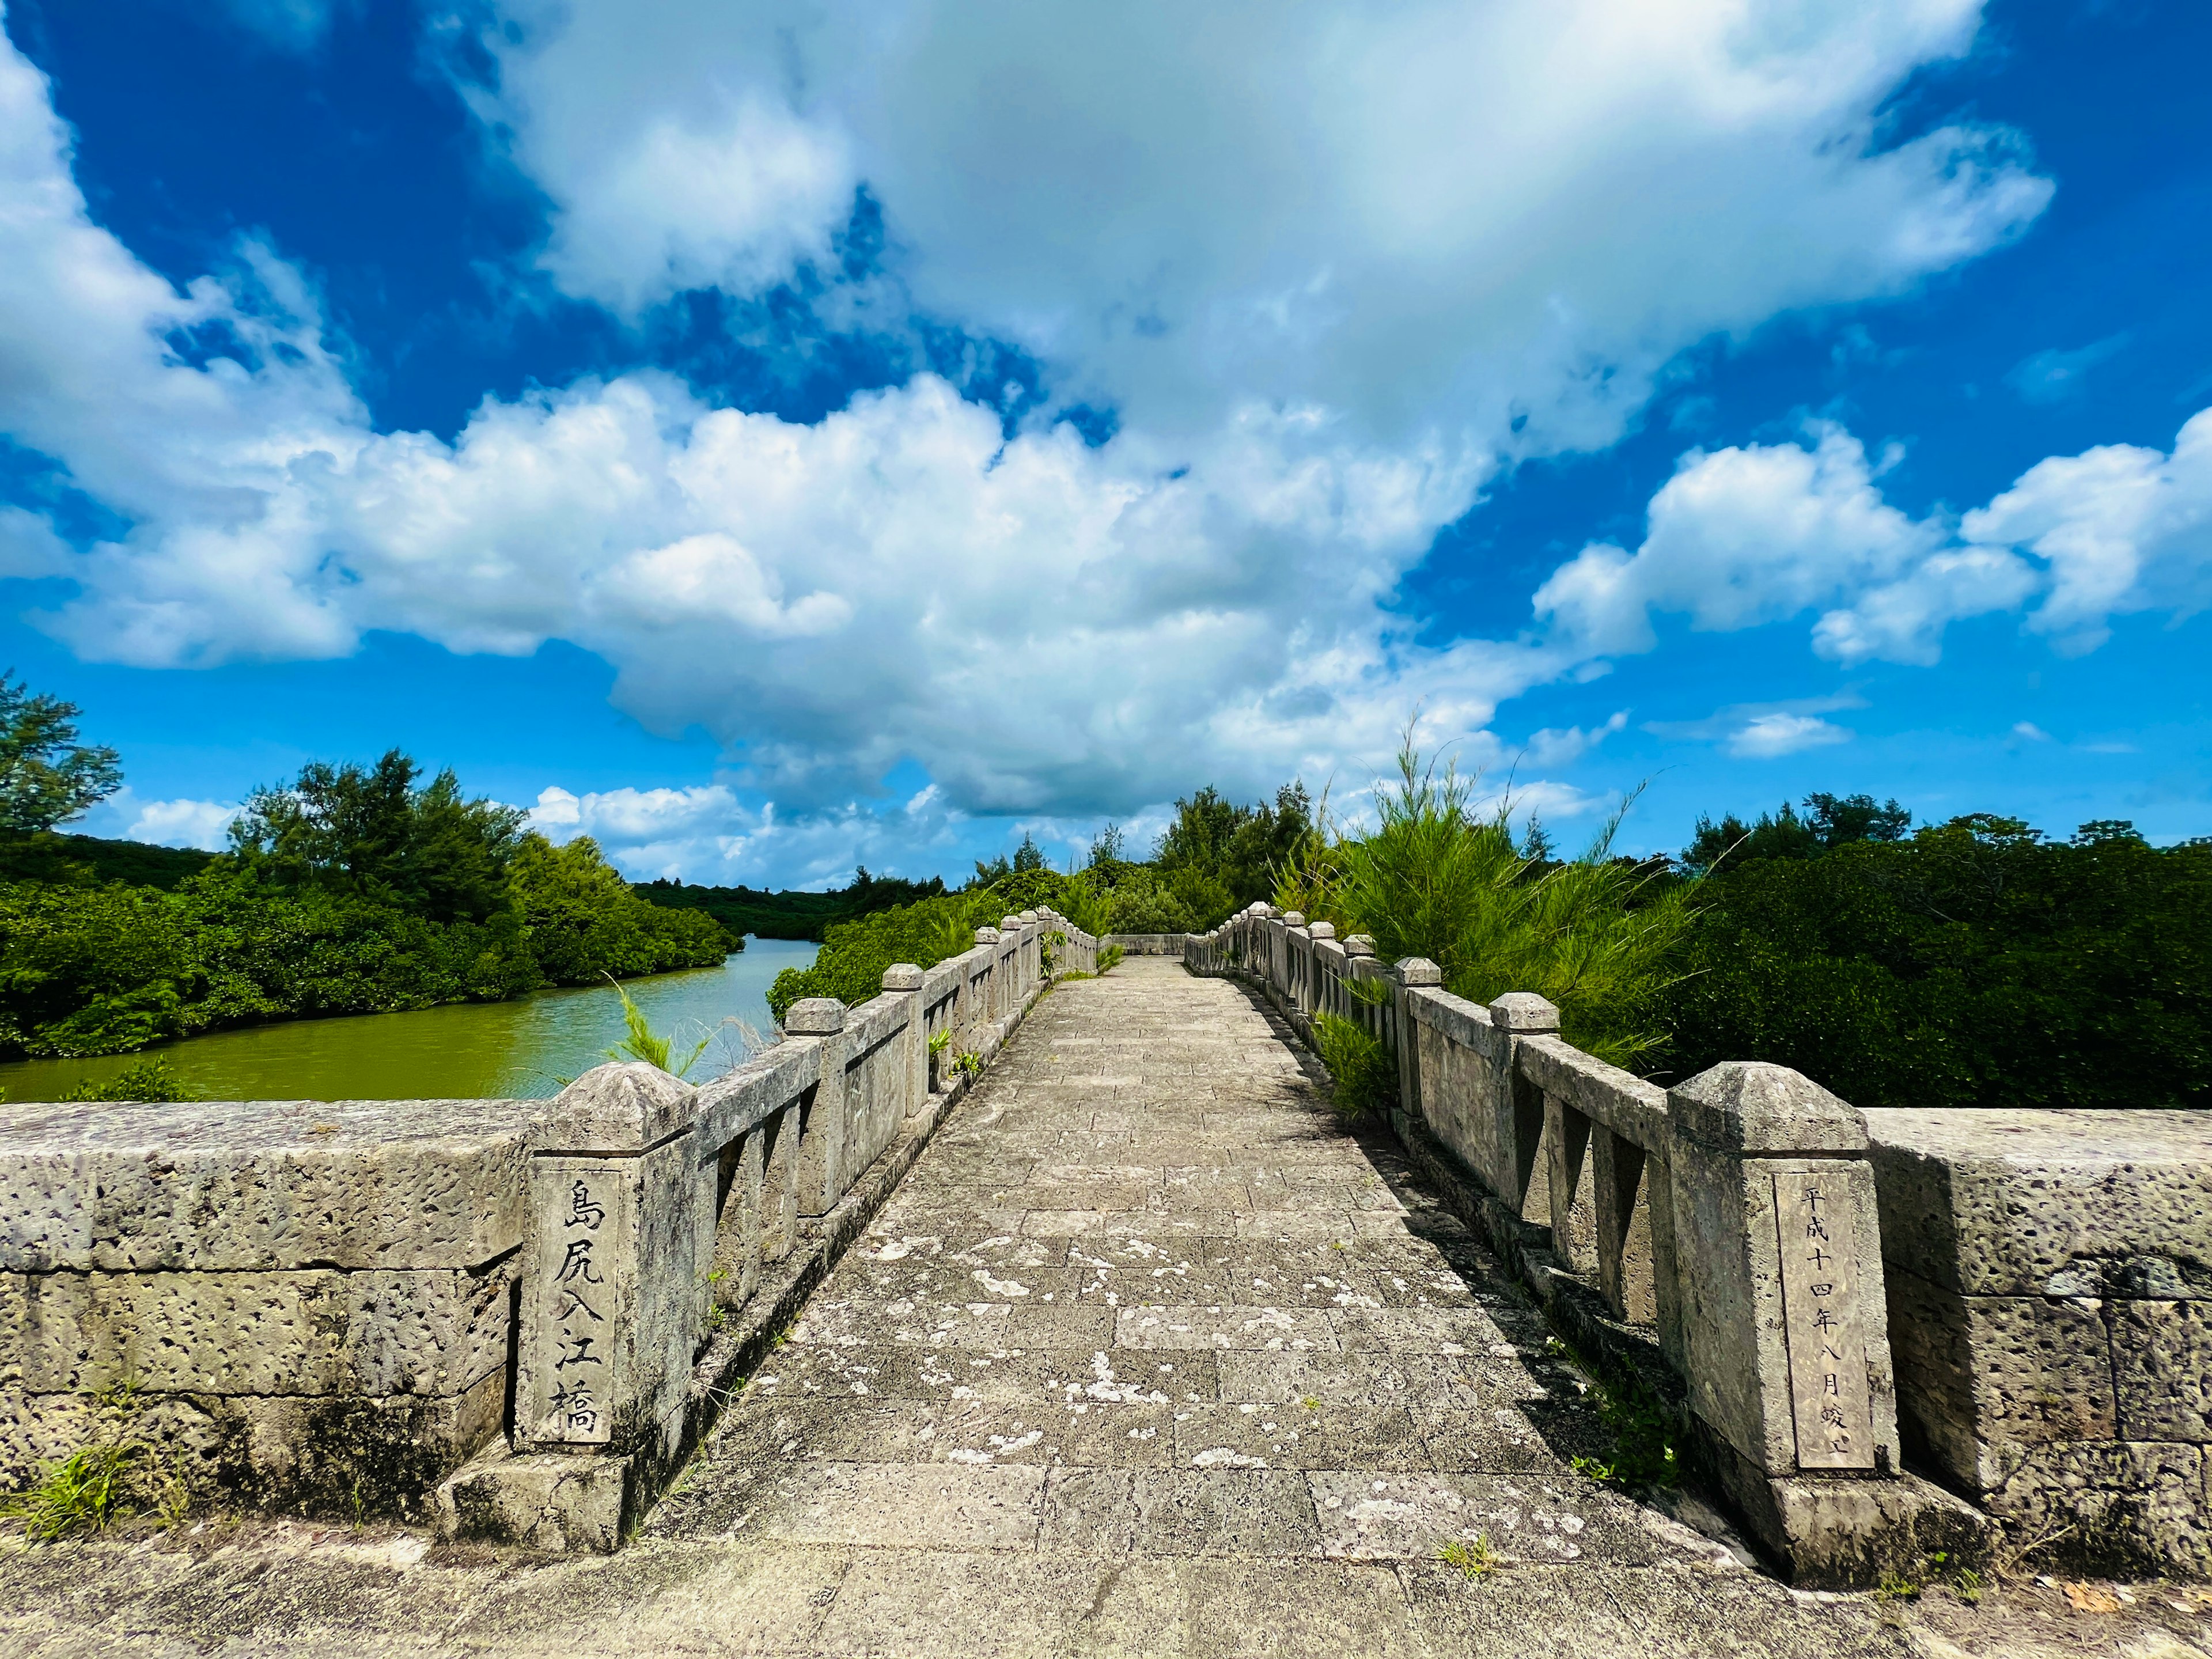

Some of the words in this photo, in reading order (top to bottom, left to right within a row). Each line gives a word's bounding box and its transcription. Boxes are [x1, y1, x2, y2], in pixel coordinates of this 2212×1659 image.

[547, 1180, 605, 1433] 島尻入江橋
